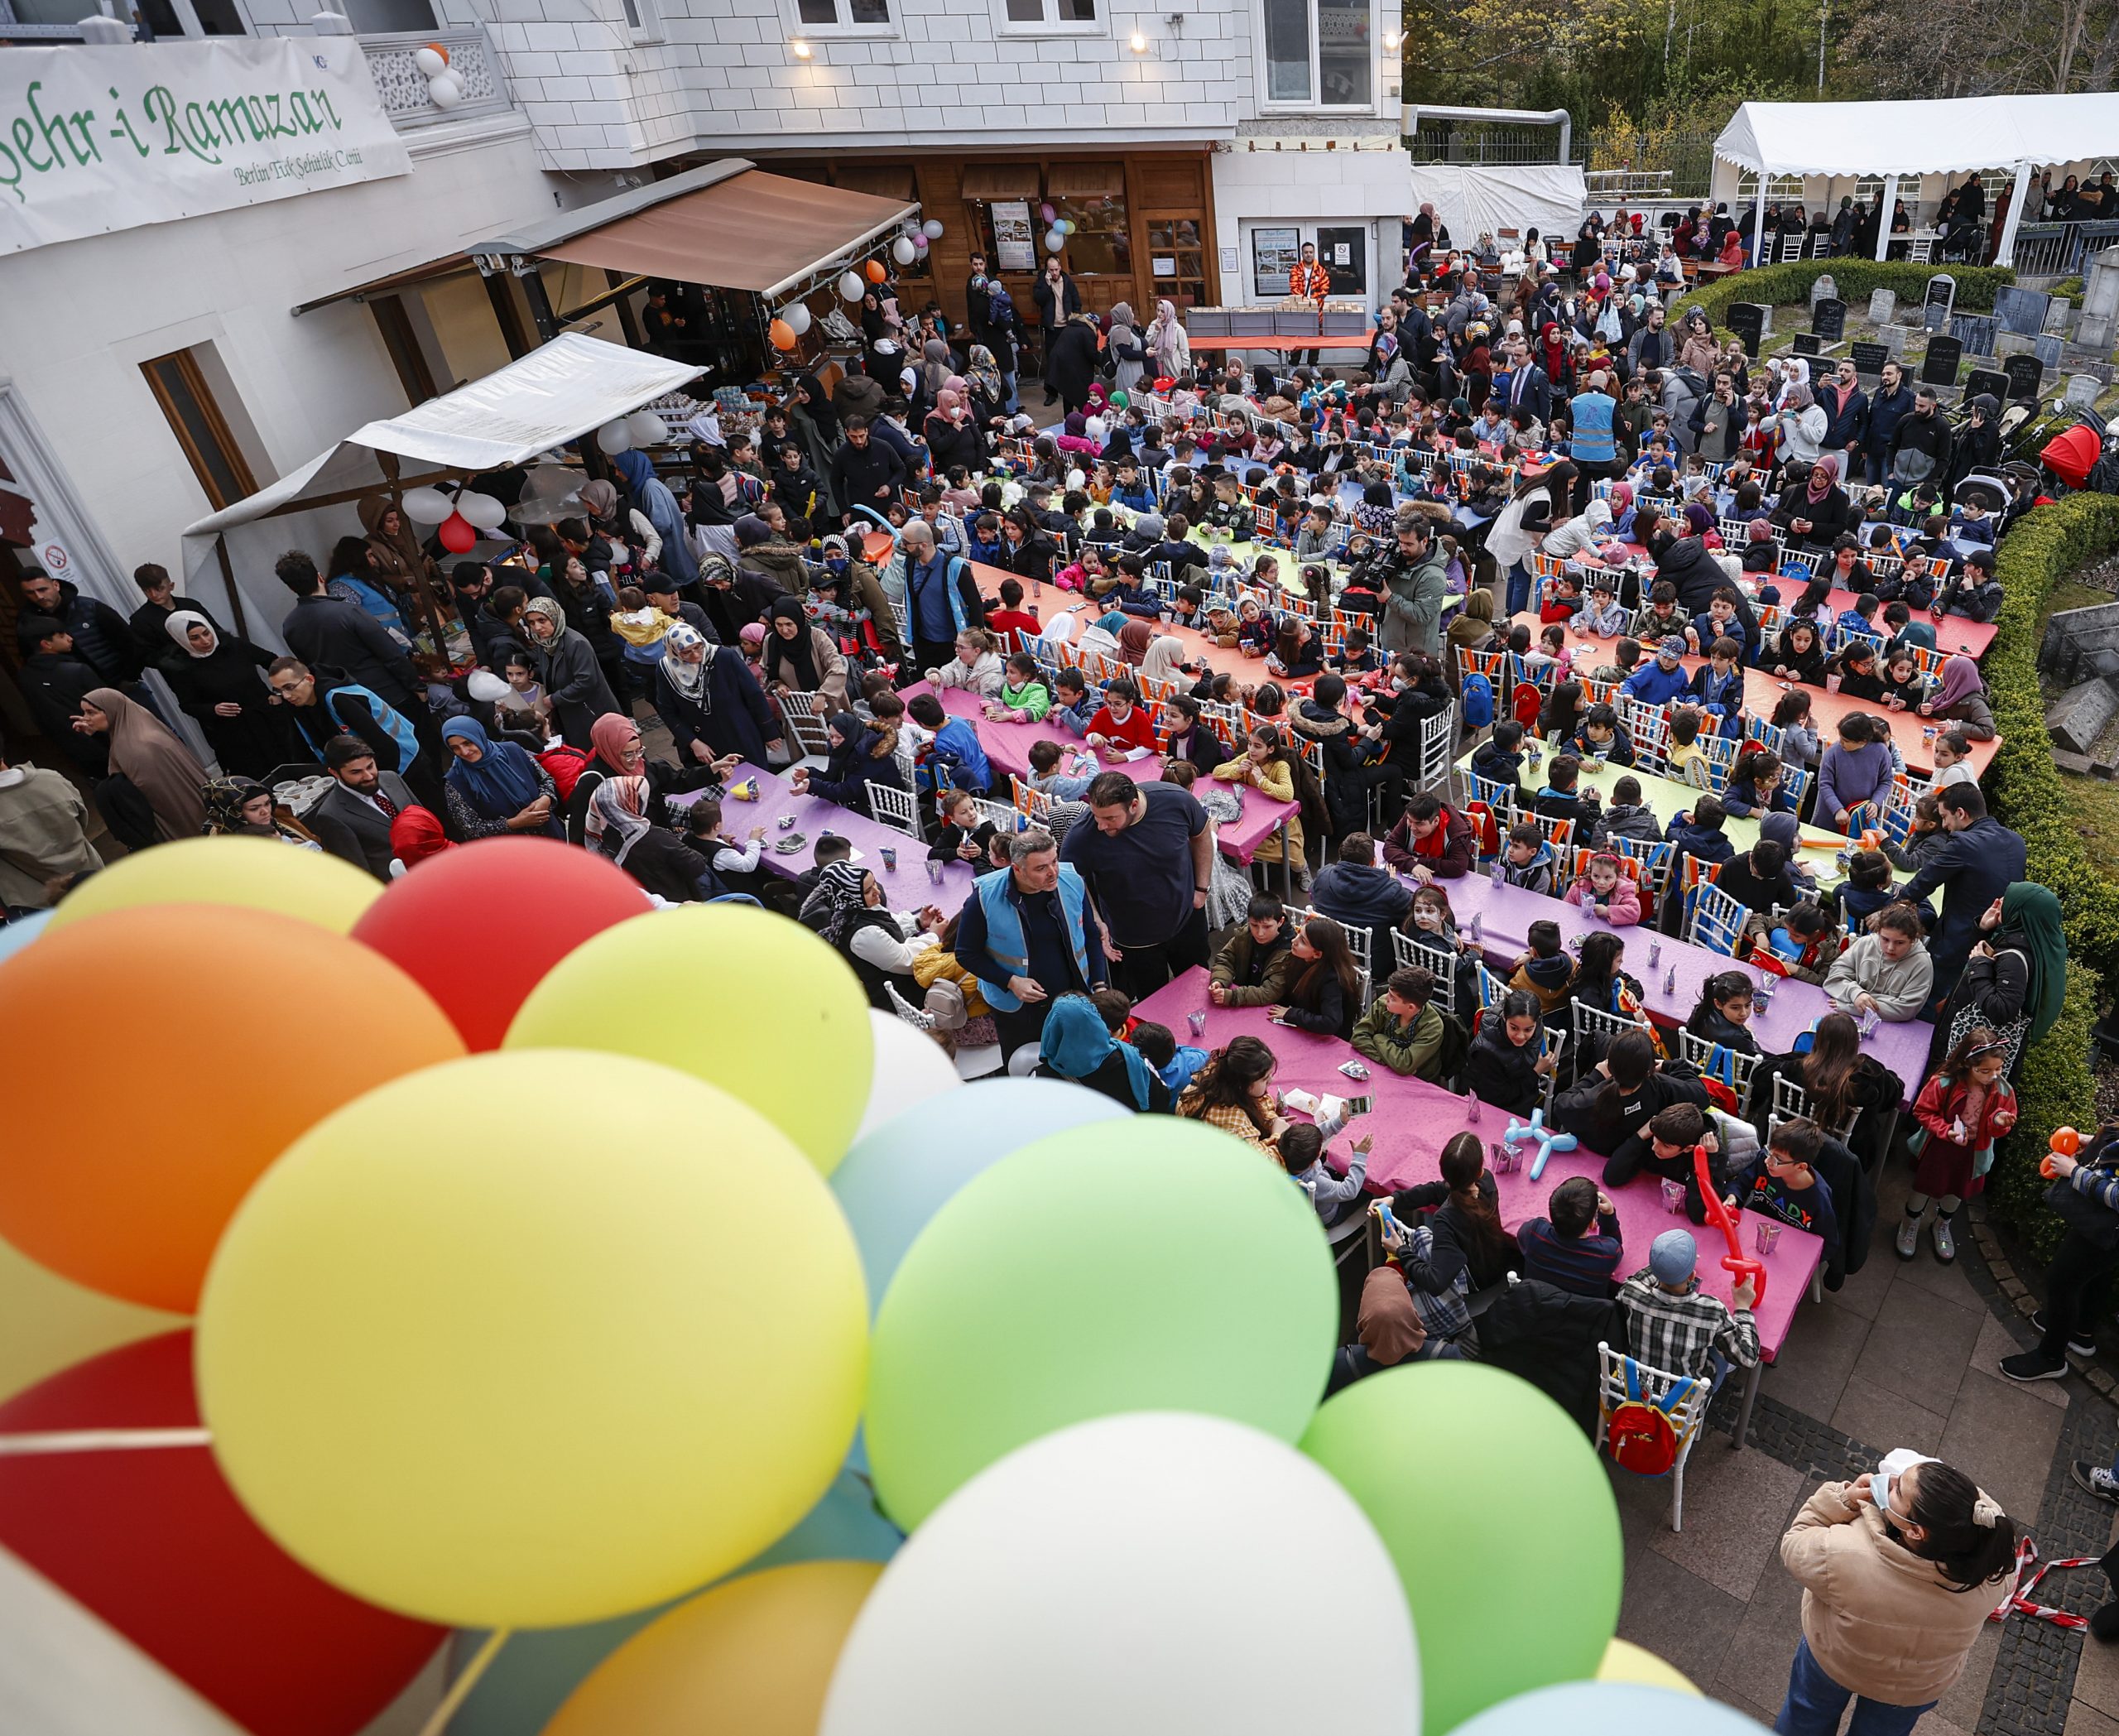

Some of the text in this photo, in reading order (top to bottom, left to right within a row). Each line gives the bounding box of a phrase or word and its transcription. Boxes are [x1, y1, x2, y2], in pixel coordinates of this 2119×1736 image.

[142, 84, 343, 166] Ramazan
[233, 161, 271, 186] Berlin
[296, 149, 341, 181] Şehitlik
[1754, 1176, 1813, 1227] READY
